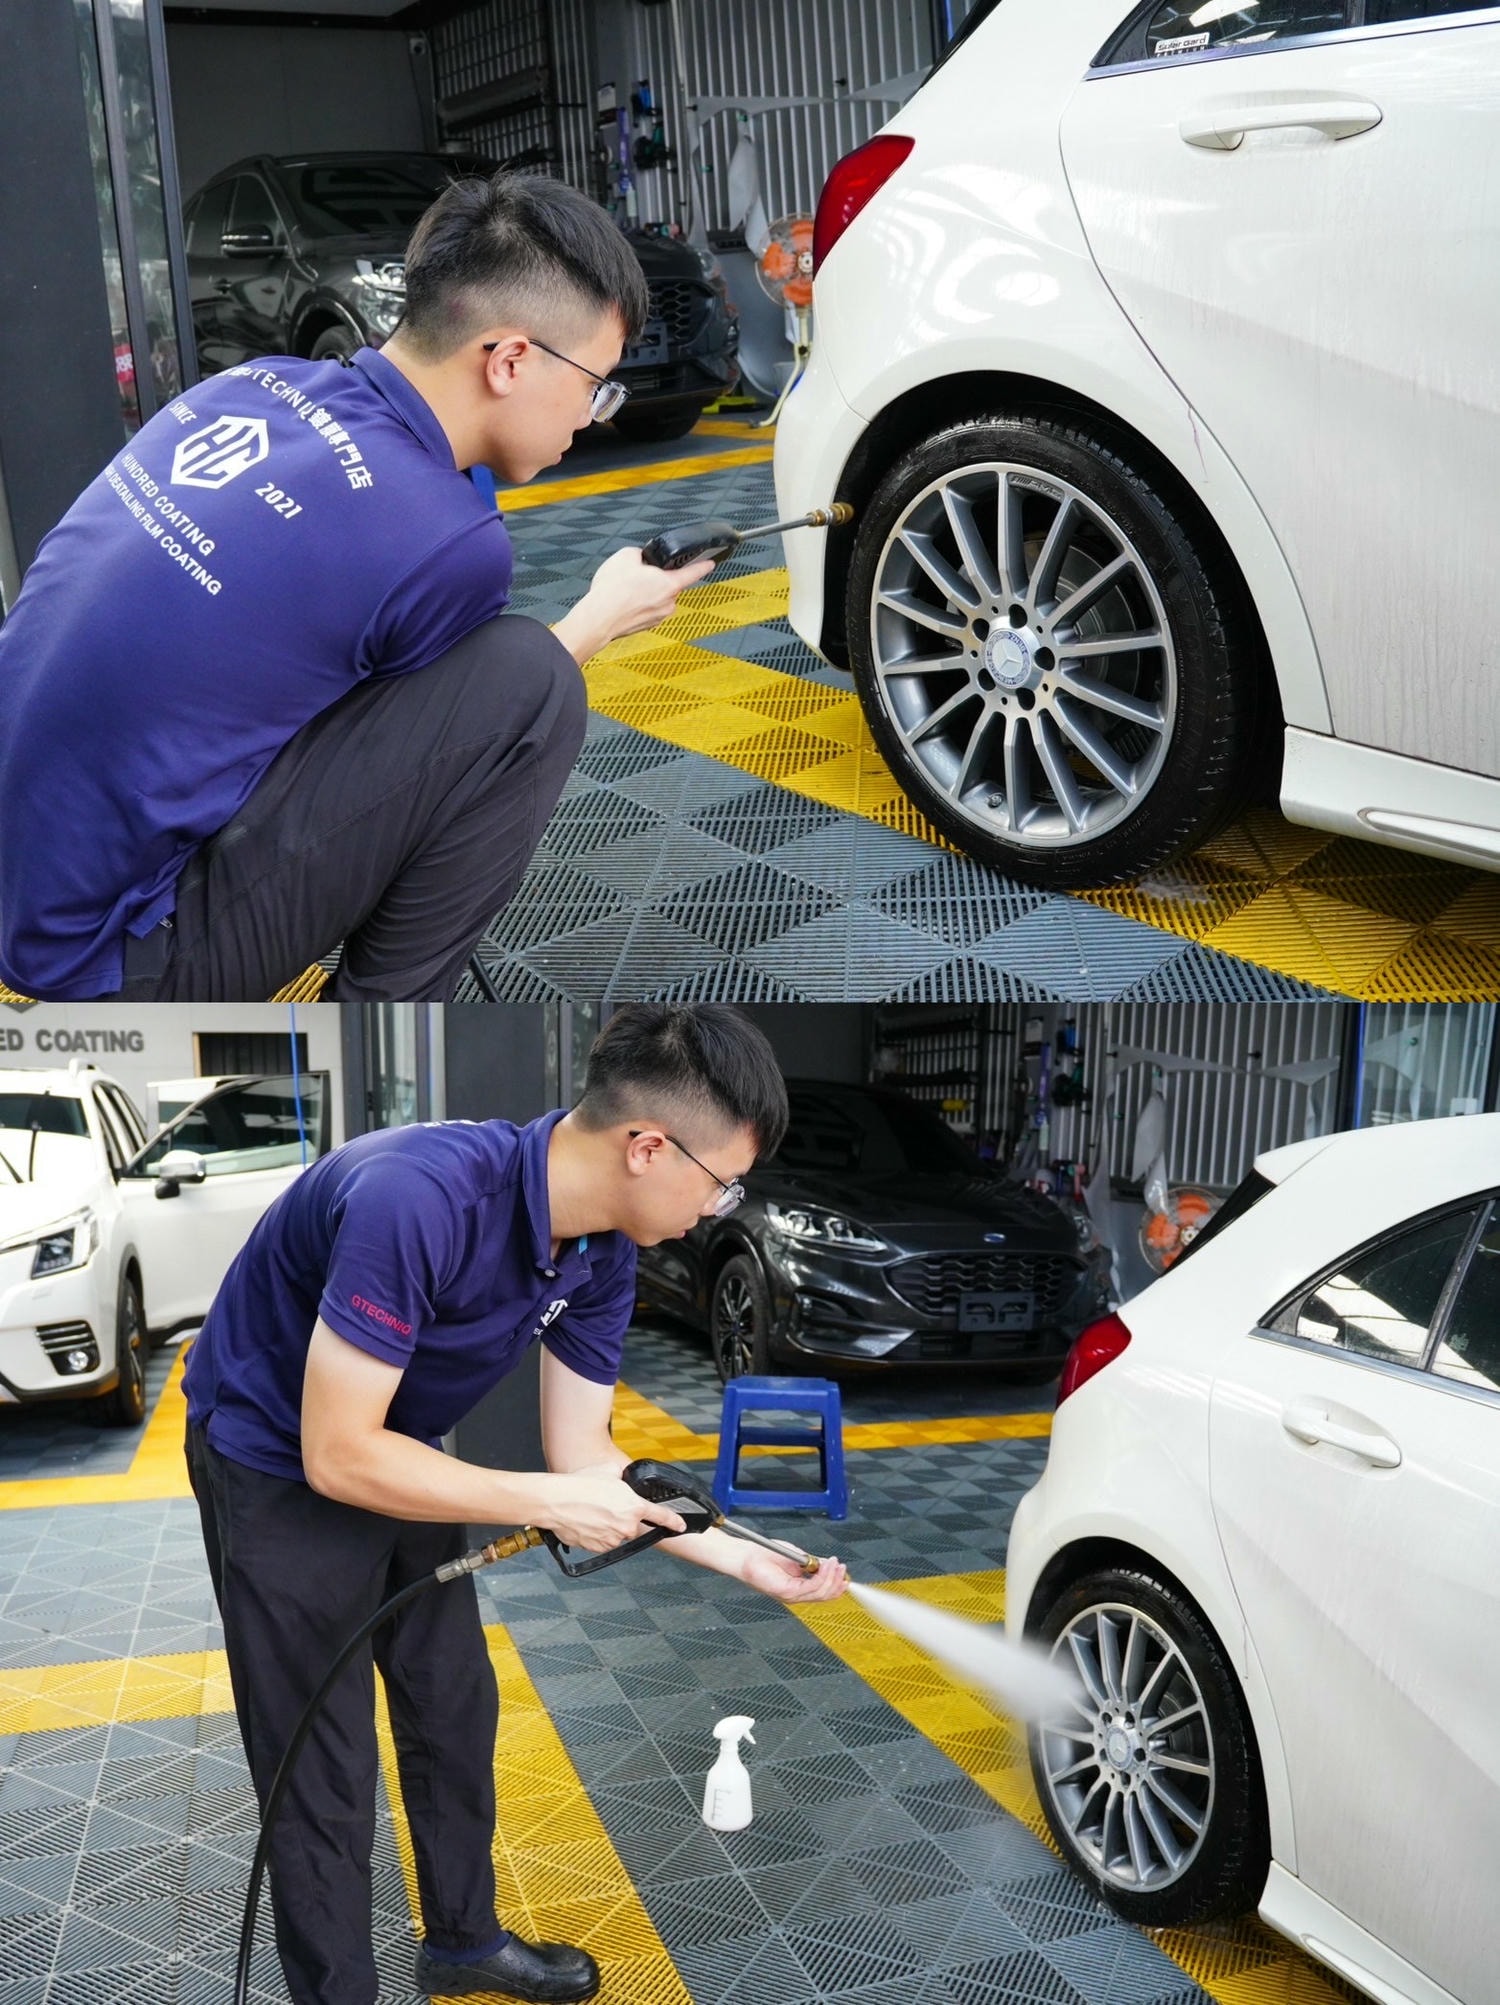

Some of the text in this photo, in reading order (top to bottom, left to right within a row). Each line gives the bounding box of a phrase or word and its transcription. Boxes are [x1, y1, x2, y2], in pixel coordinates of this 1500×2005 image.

[168, 401, 198, 425] SINCE
[122, 452, 216, 556] HUNDRED COATING
[254, 482, 303, 520] 2021
[138, 512, 165, 539] FILM
[160, 535, 223, 596] COATING
[35, 1028, 144, 1052] COATING
[351, 1294, 412, 1336] GTECHNIQ
